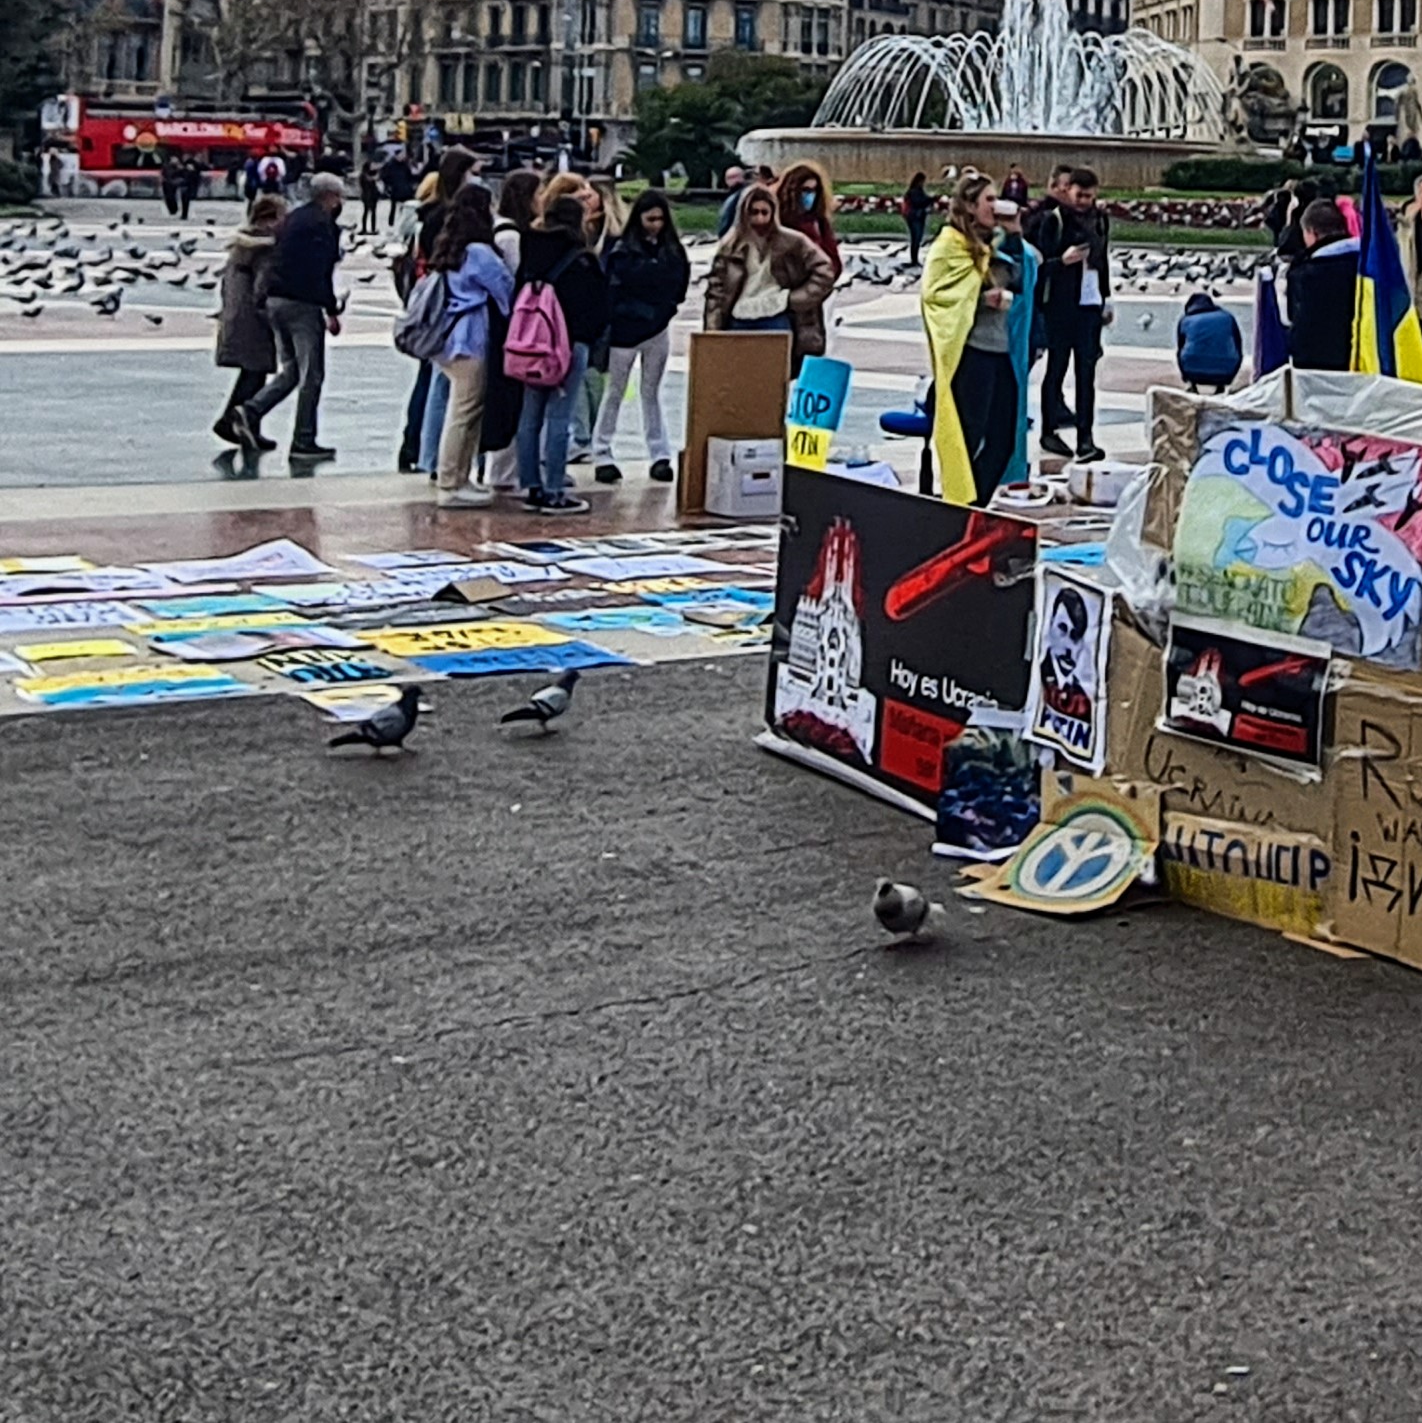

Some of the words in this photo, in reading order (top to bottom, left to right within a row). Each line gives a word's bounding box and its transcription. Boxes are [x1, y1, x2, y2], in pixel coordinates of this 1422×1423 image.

[1223, 429, 1340, 519] CLOSE
[1306, 516, 1380, 554] OUR
[1330, 550, 1416, 621] SKY
[890, 658, 918, 697] Hoy
[920, 676, 938, 699] es
